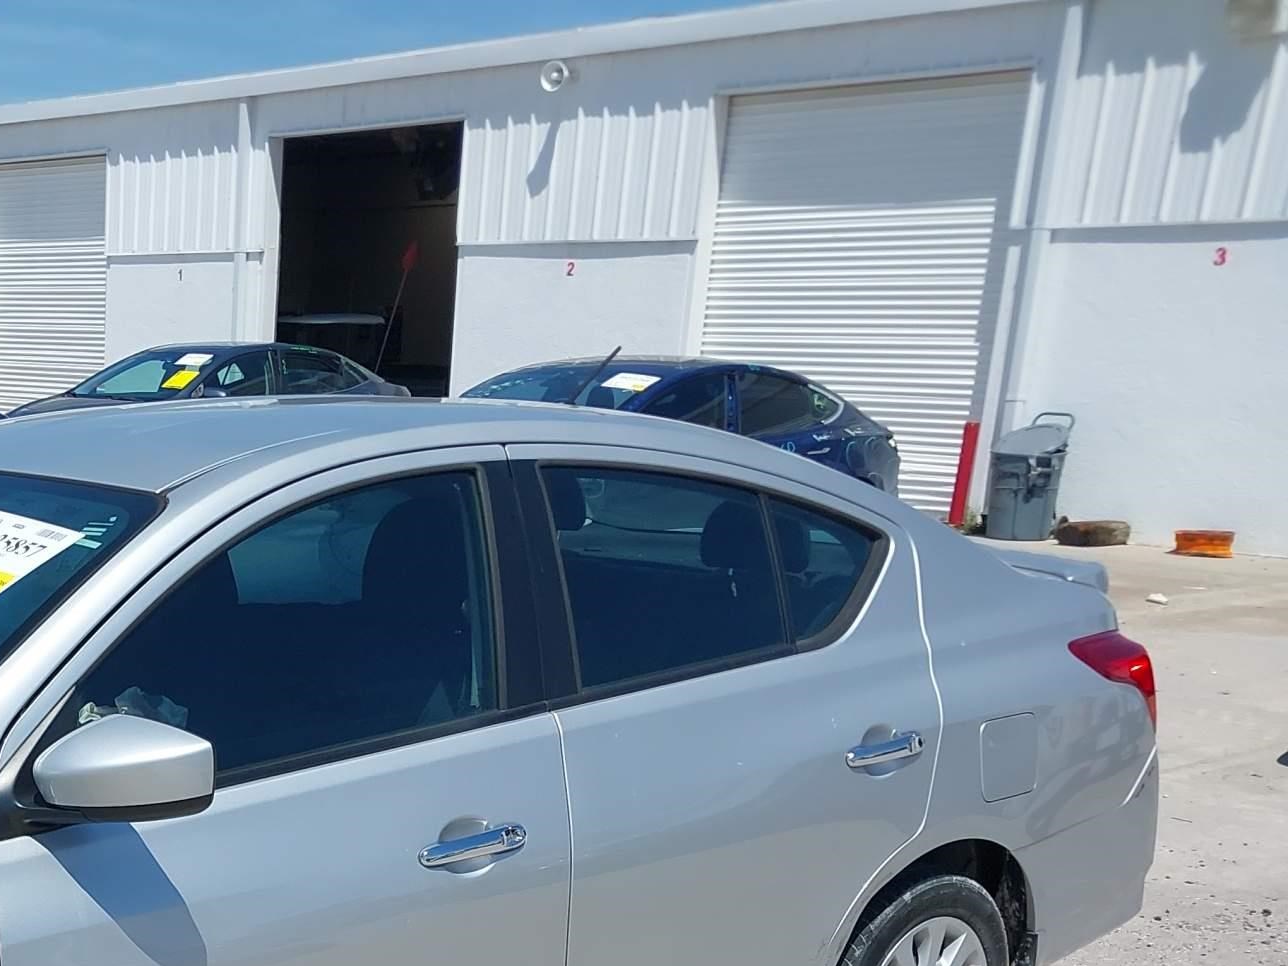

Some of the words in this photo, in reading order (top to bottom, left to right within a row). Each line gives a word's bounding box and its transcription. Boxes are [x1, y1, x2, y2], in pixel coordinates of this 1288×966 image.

[1213, 247, 1227, 266] 3
[177, 269, 183, 281] 1
[566, 262, 576, 276] 2
